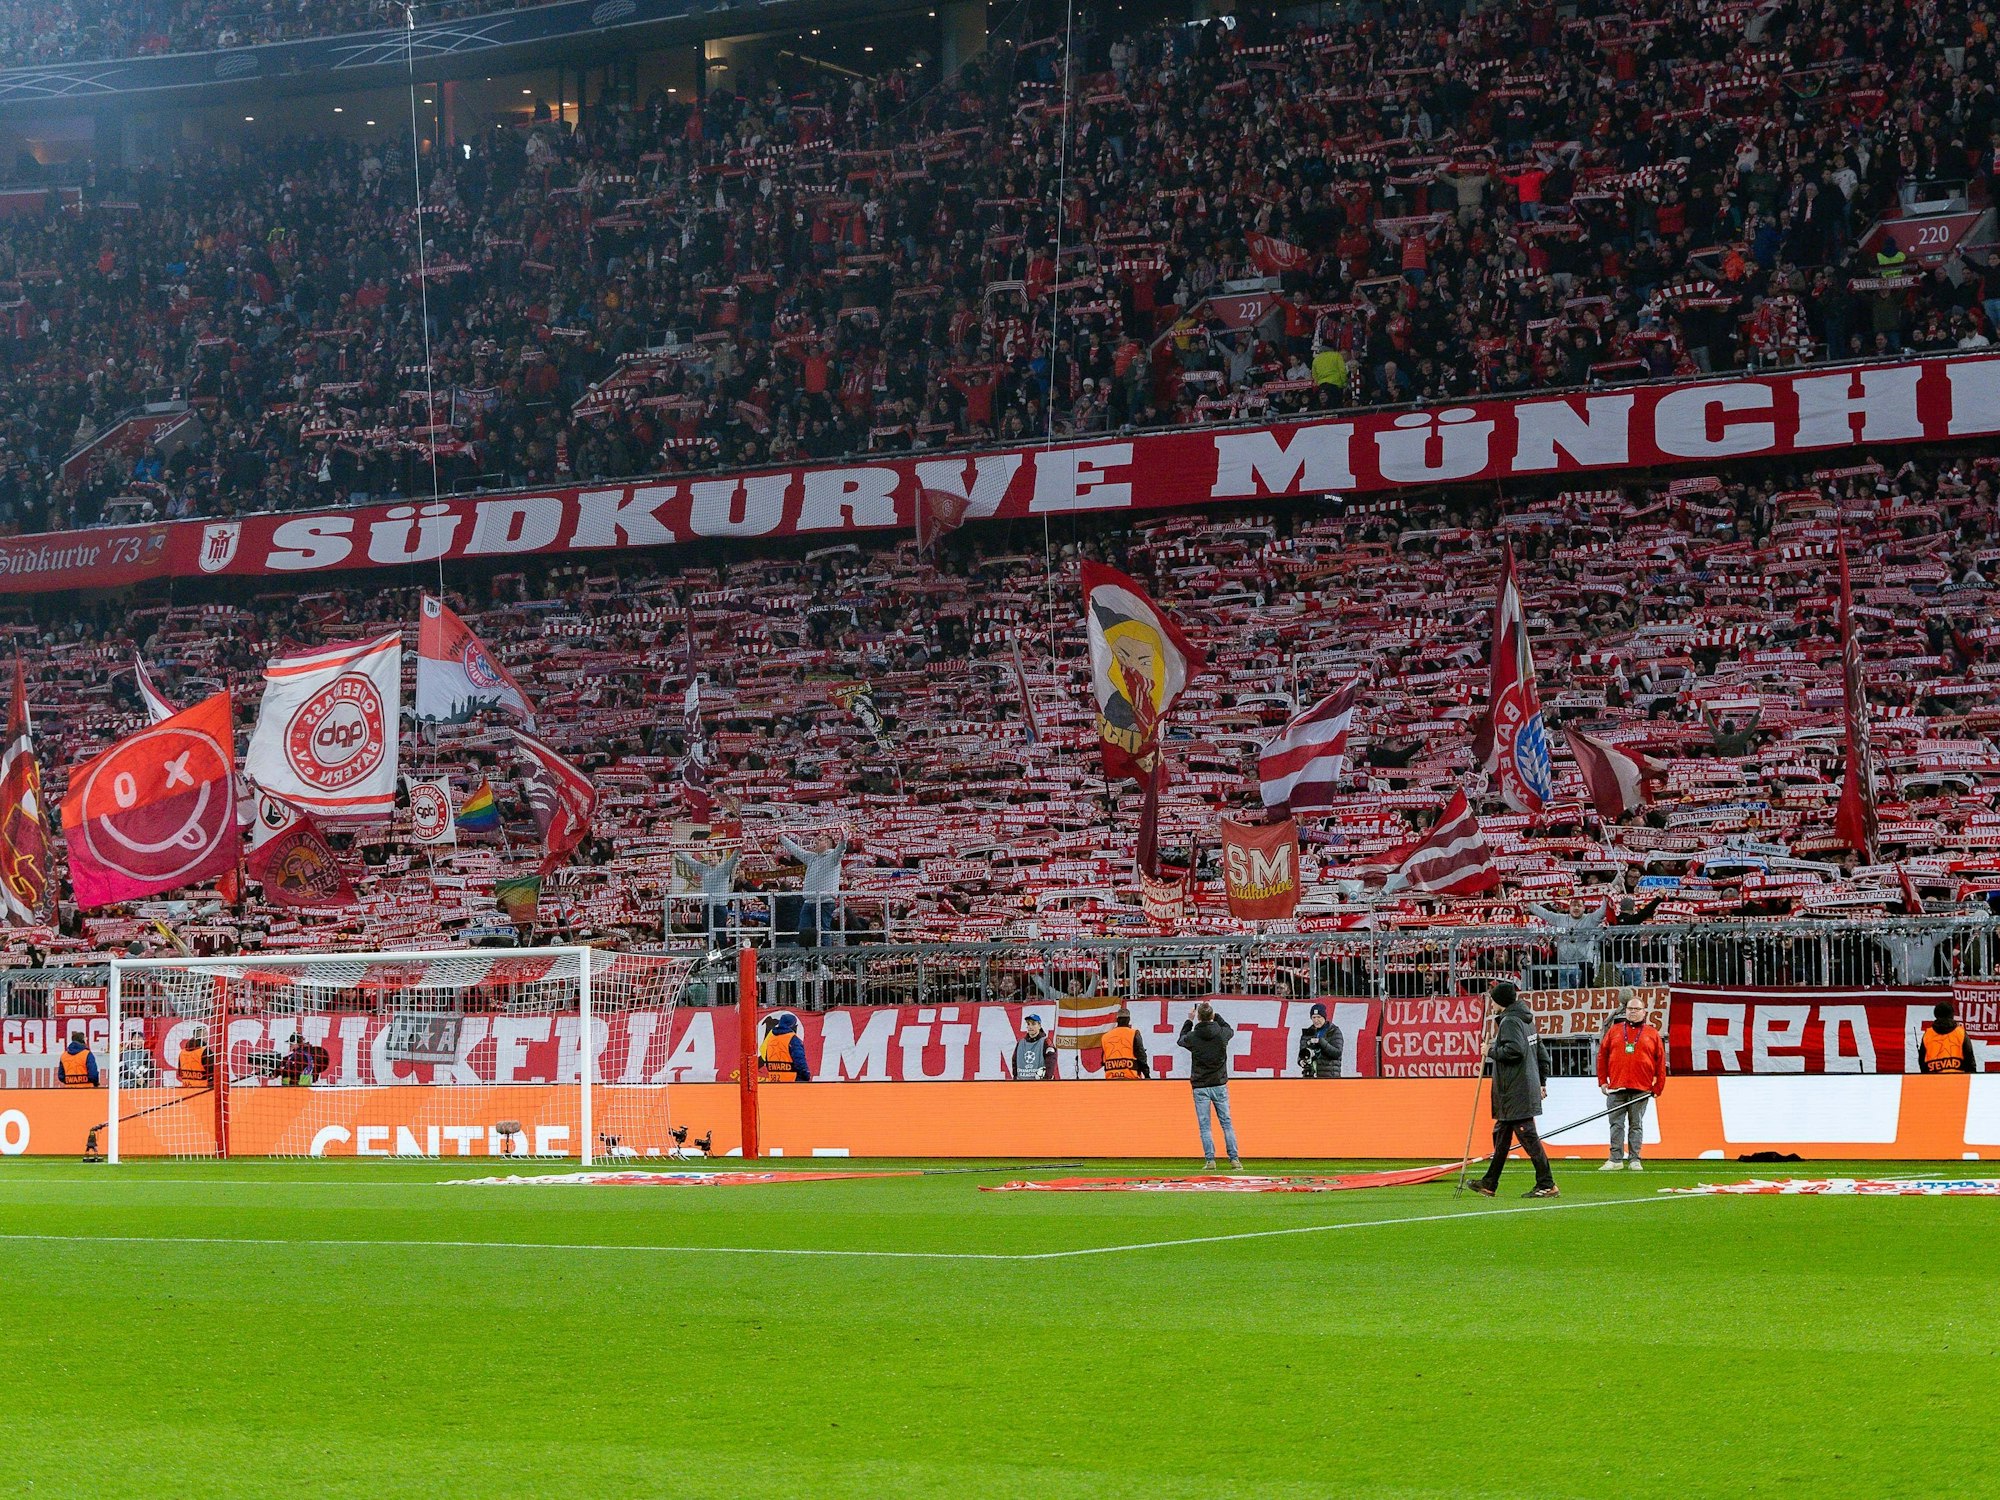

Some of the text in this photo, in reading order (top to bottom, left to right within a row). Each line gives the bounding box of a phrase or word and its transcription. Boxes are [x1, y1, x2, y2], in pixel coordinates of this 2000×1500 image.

[1919, 226, 1949, 245] 220
[1239, 302, 1262, 318] 221
[1170, 328, 1200, 337] AYERN
[265, 443, 1134, 571] SÜDKURVE
[0, 536, 143, 575] Südkurve '73
[1805, 688, 1844, 697] SÜDKUR
[1061, 712, 1095, 721] SÜDKUR
[1227, 843, 1292, 890] SM
[1766, 874, 1816, 884] MÜNCHE
[1230, 878, 1294, 899] Südkurve
[1574, 887, 1612, 898] KER
[1174, 918, 1240, 927] ULT RAS
[1301, 918, 1341, 931] BAYERN
[1137, 968, 1211, 978] SCHICKERI
[1387, 1000, 1481, 1026] ULTRAS
[1954, 1002, 2000, 1024] JUN
[1383, 1031, 1481, 1057] GEGEN
[1105, 1060, 1133, 1069] TEWARD
